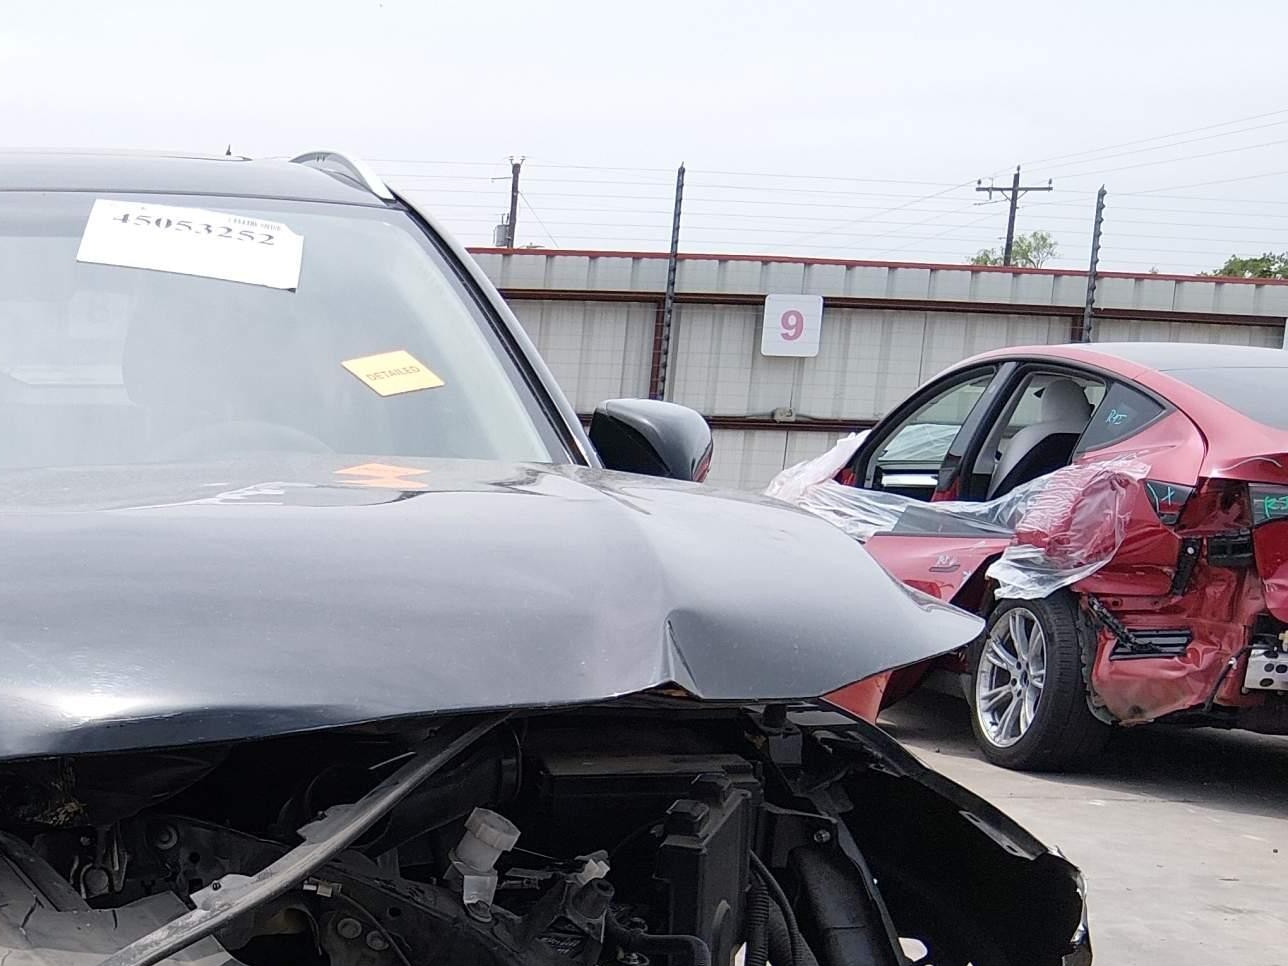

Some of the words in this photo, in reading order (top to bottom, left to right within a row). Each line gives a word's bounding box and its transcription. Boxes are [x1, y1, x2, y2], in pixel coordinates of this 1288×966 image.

[112, 212, 275, 246] 45053252
[780, 309, 804, 341] 9
[365, 365, 421, 381] DETAILED
